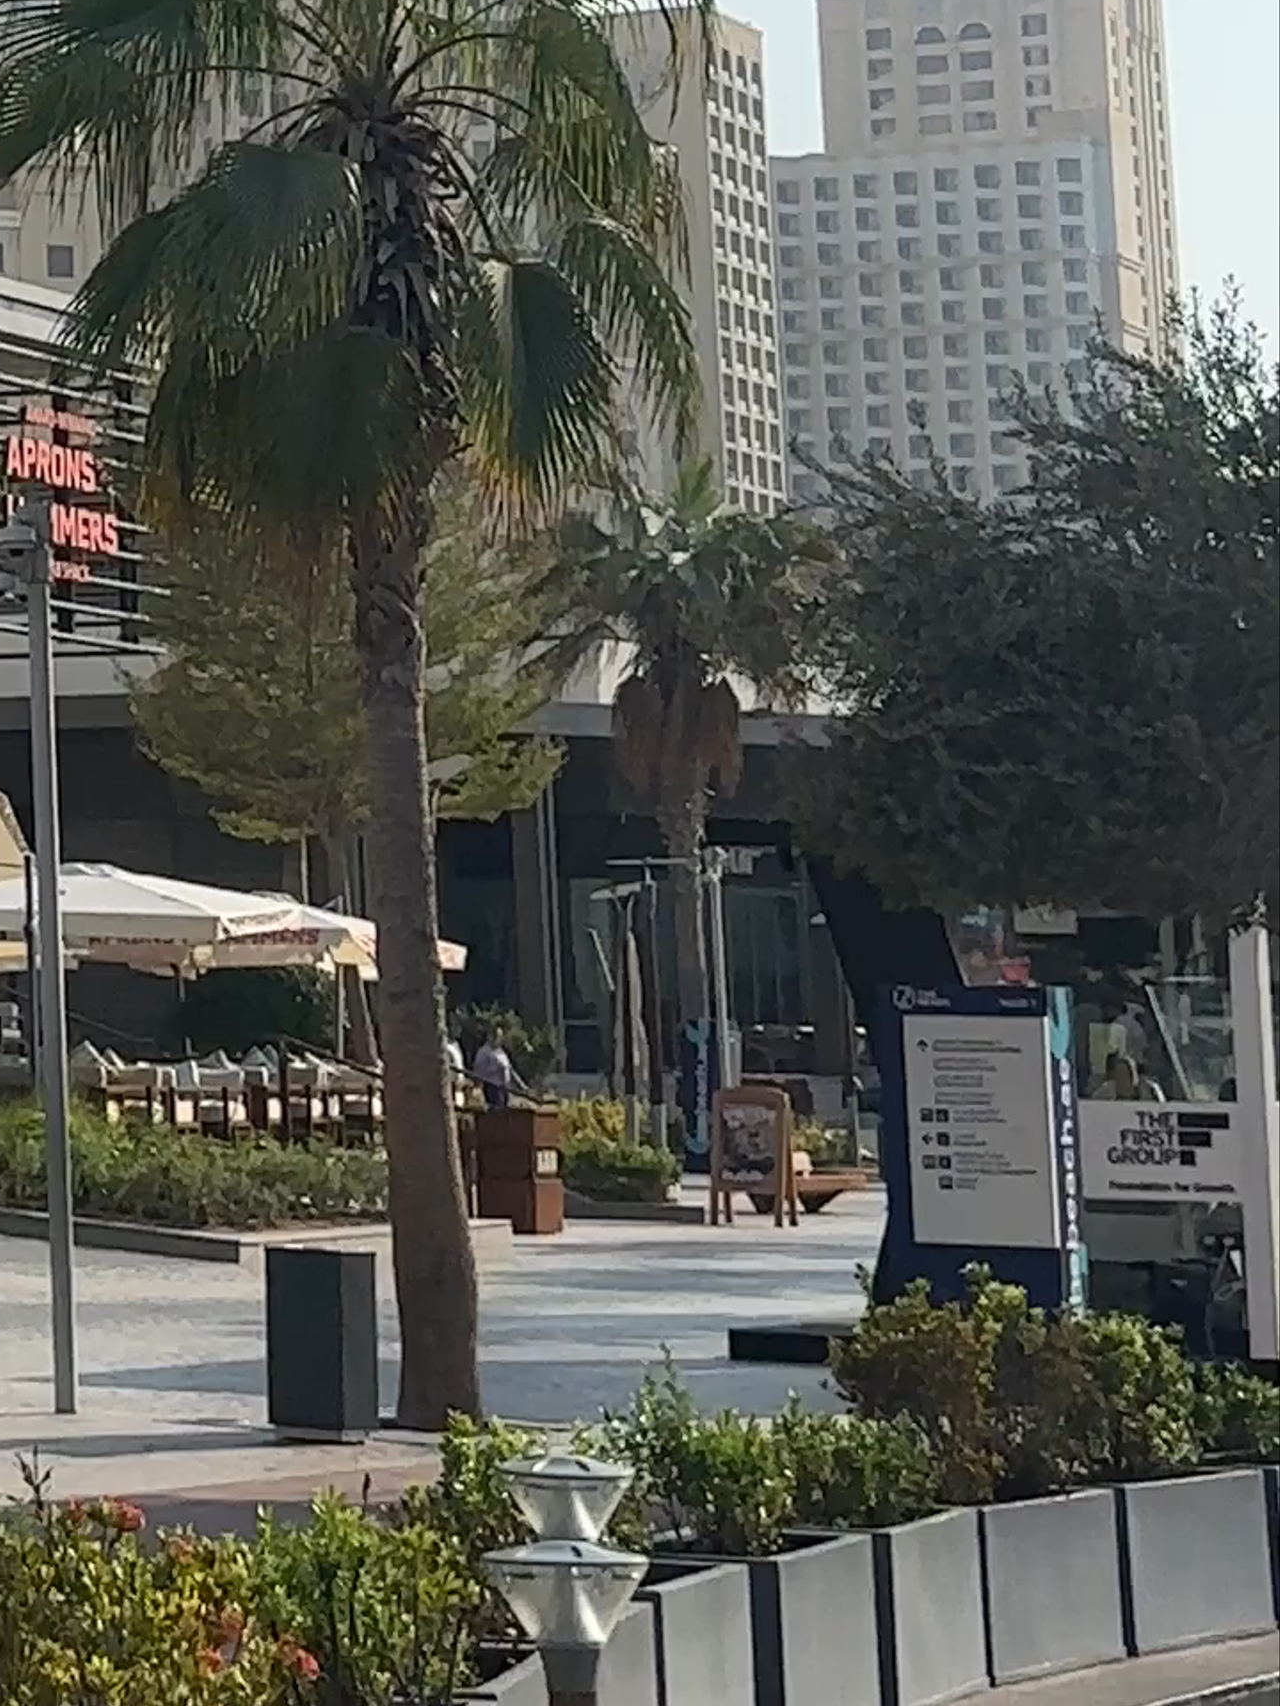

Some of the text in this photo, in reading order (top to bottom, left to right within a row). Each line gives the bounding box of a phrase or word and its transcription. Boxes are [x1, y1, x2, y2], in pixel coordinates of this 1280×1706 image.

[6, 436, 98, 493] APRONS
[7, 494, 119, 555] MERS
[1135, 1110, 1176, 1128] THE
[1119, 1127, 1176, 1147] FIRST
[1106, 1145, 1180, 1166] GROUP
